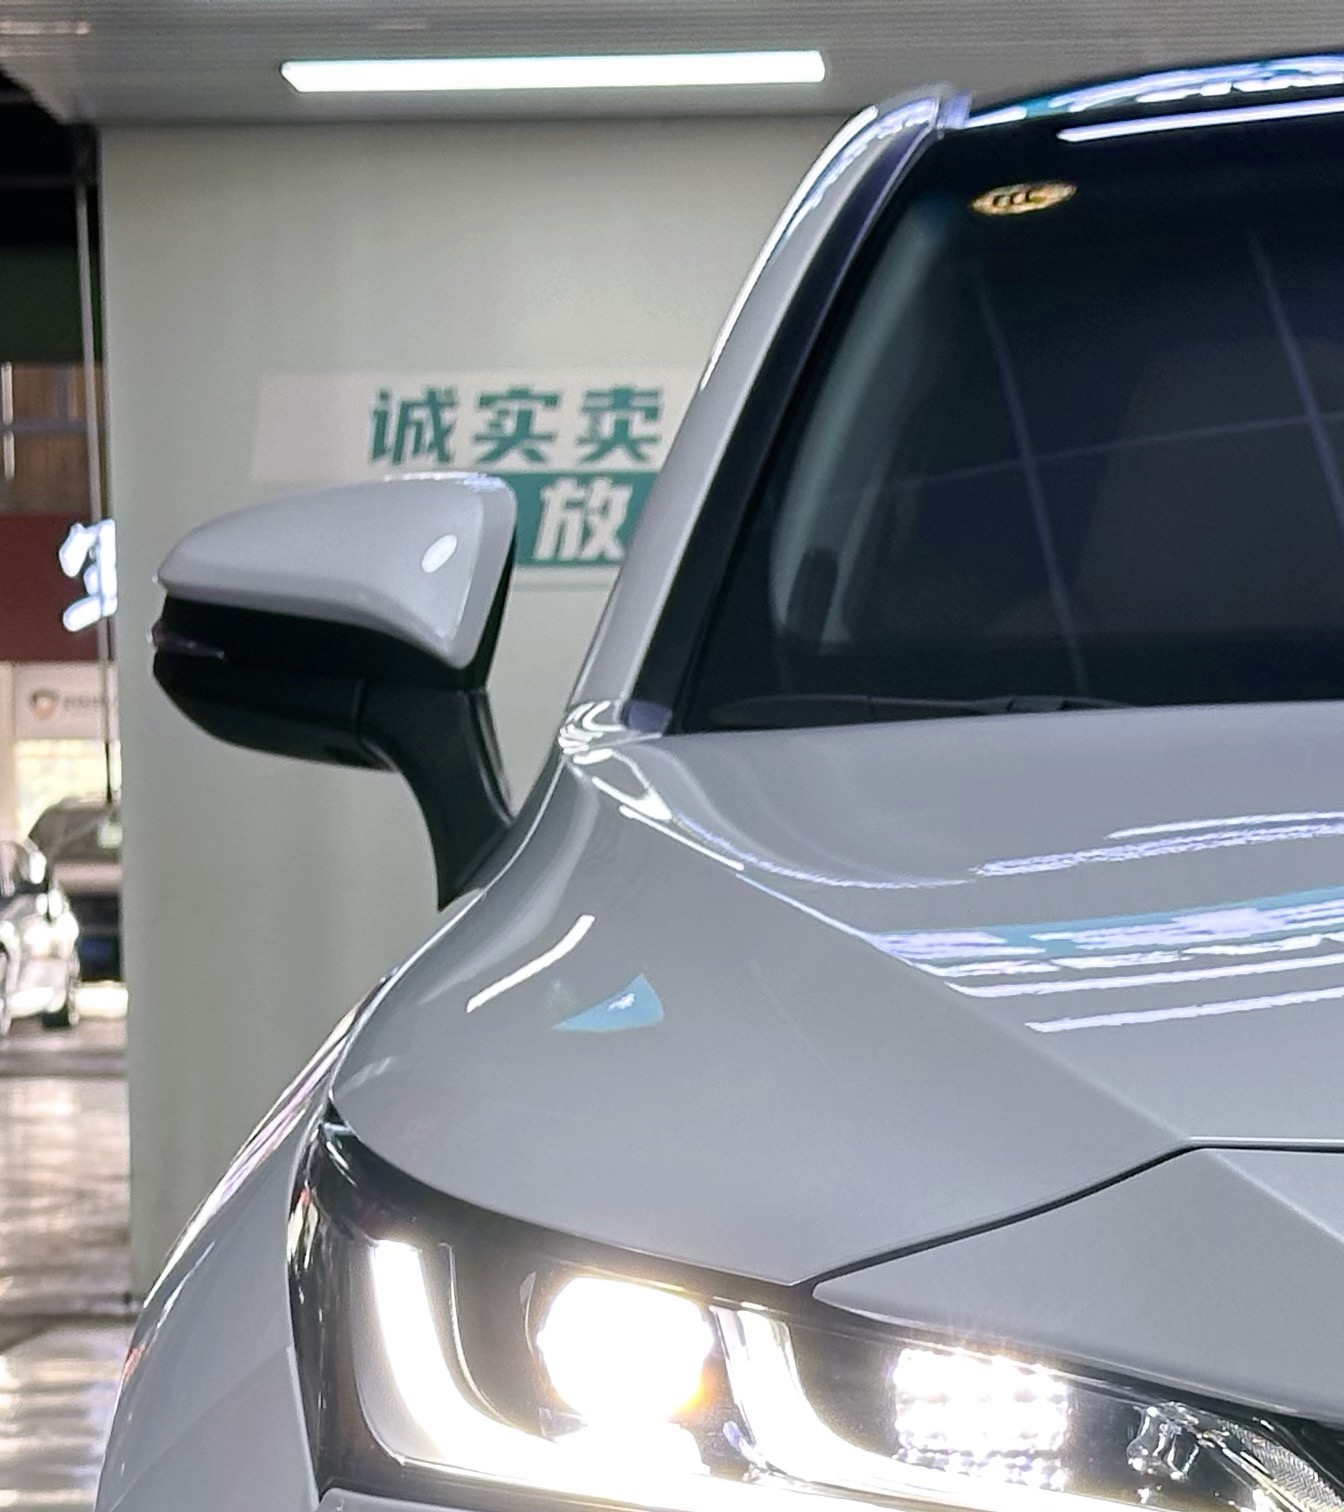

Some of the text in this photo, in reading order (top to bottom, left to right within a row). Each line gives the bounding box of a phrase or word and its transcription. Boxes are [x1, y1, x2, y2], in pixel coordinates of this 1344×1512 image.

[369, 385, 665, 466] 诚实卖
[534, 477, 634, 562] 放
